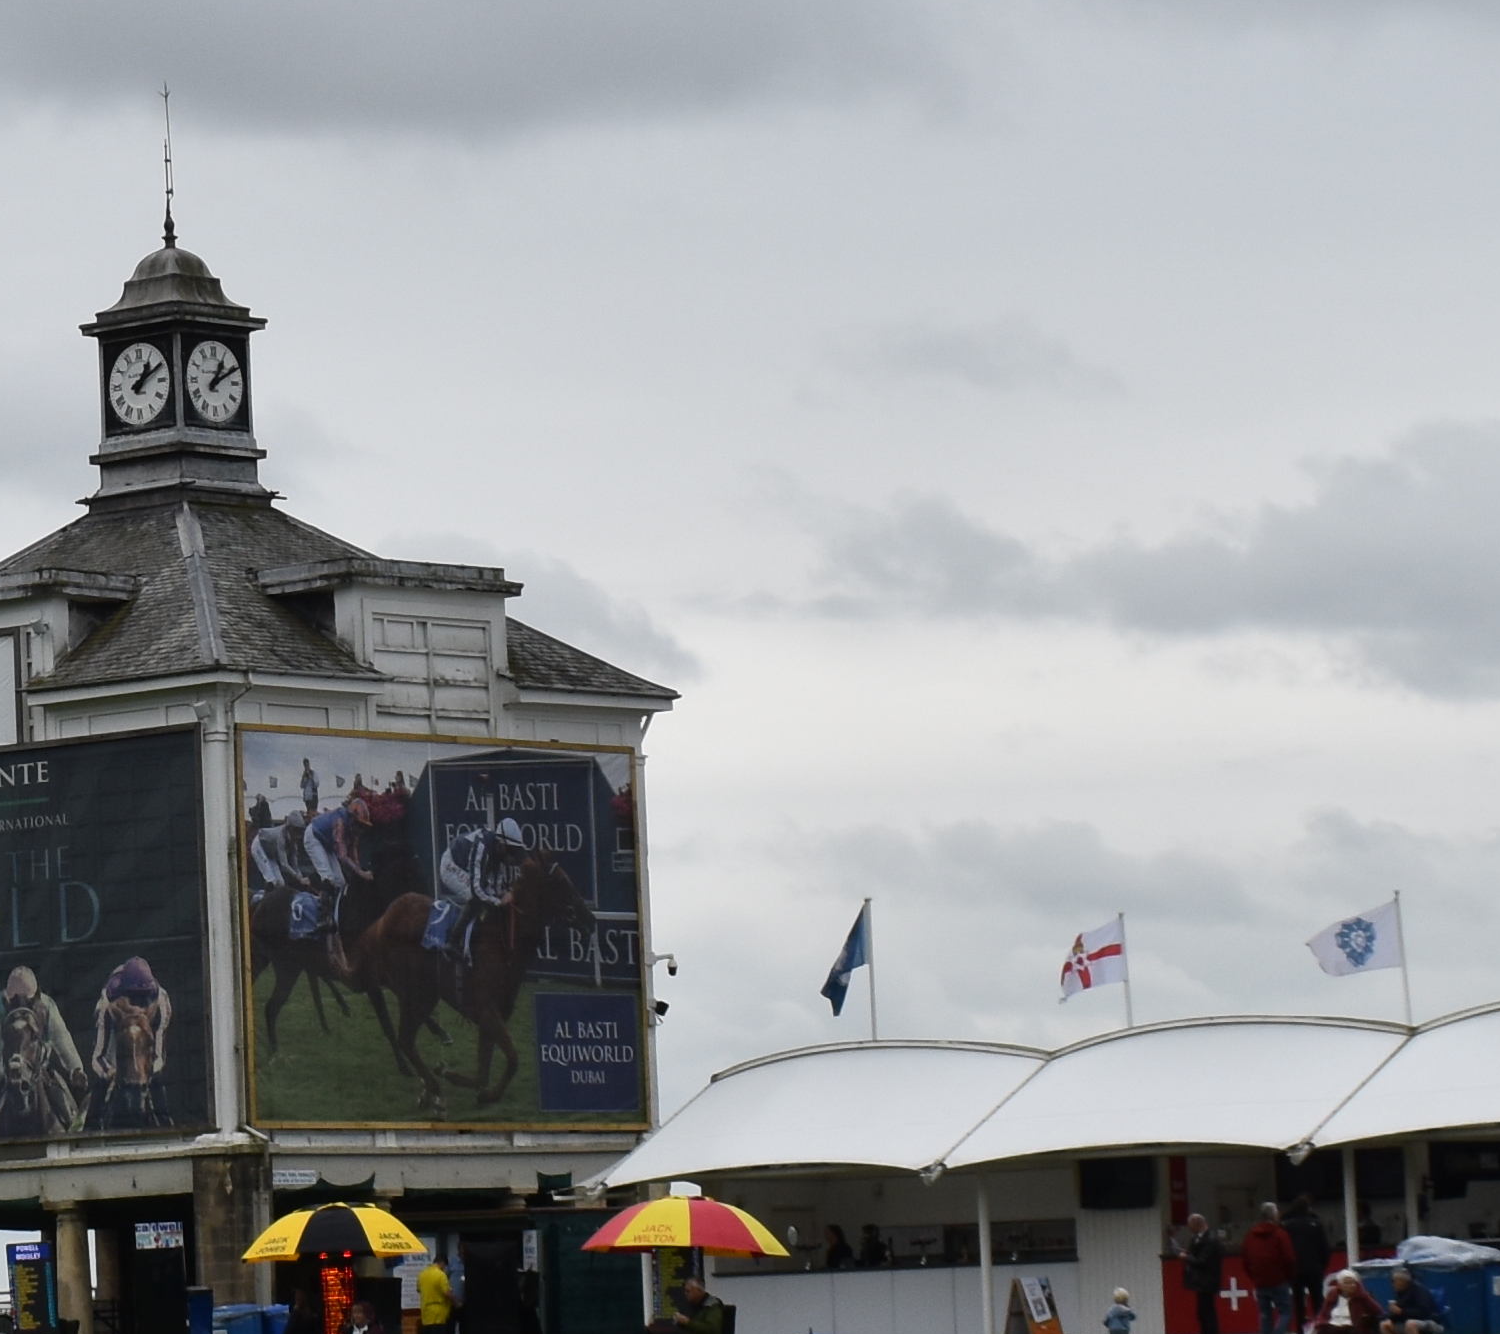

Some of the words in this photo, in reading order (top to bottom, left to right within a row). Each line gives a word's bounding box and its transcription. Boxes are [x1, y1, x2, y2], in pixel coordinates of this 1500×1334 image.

[499, 783, 559, 811] BASTI
[446, 823, 583, 852] EORLD
[6, 846, 73, 883] THE
[433, 900, 451, 925] 9
[555, 1022, 572, 1039] AL
[578, 1021, 618, 1039] BASTI
[541, 1044, 634, 1066] EQUIWORLD
[571, 1070, 606, 1084] DUBAI
[642, 1224, 673, 1233] JACK
[264, 1236, 288, 1245] JACK
[378, 1232, 402, 1240] JACK
[632, 1233, 676, 1243] WILTON
[256, 1245, 286, 1255] JONES
[381, 1242, 412, 1250] JONES
